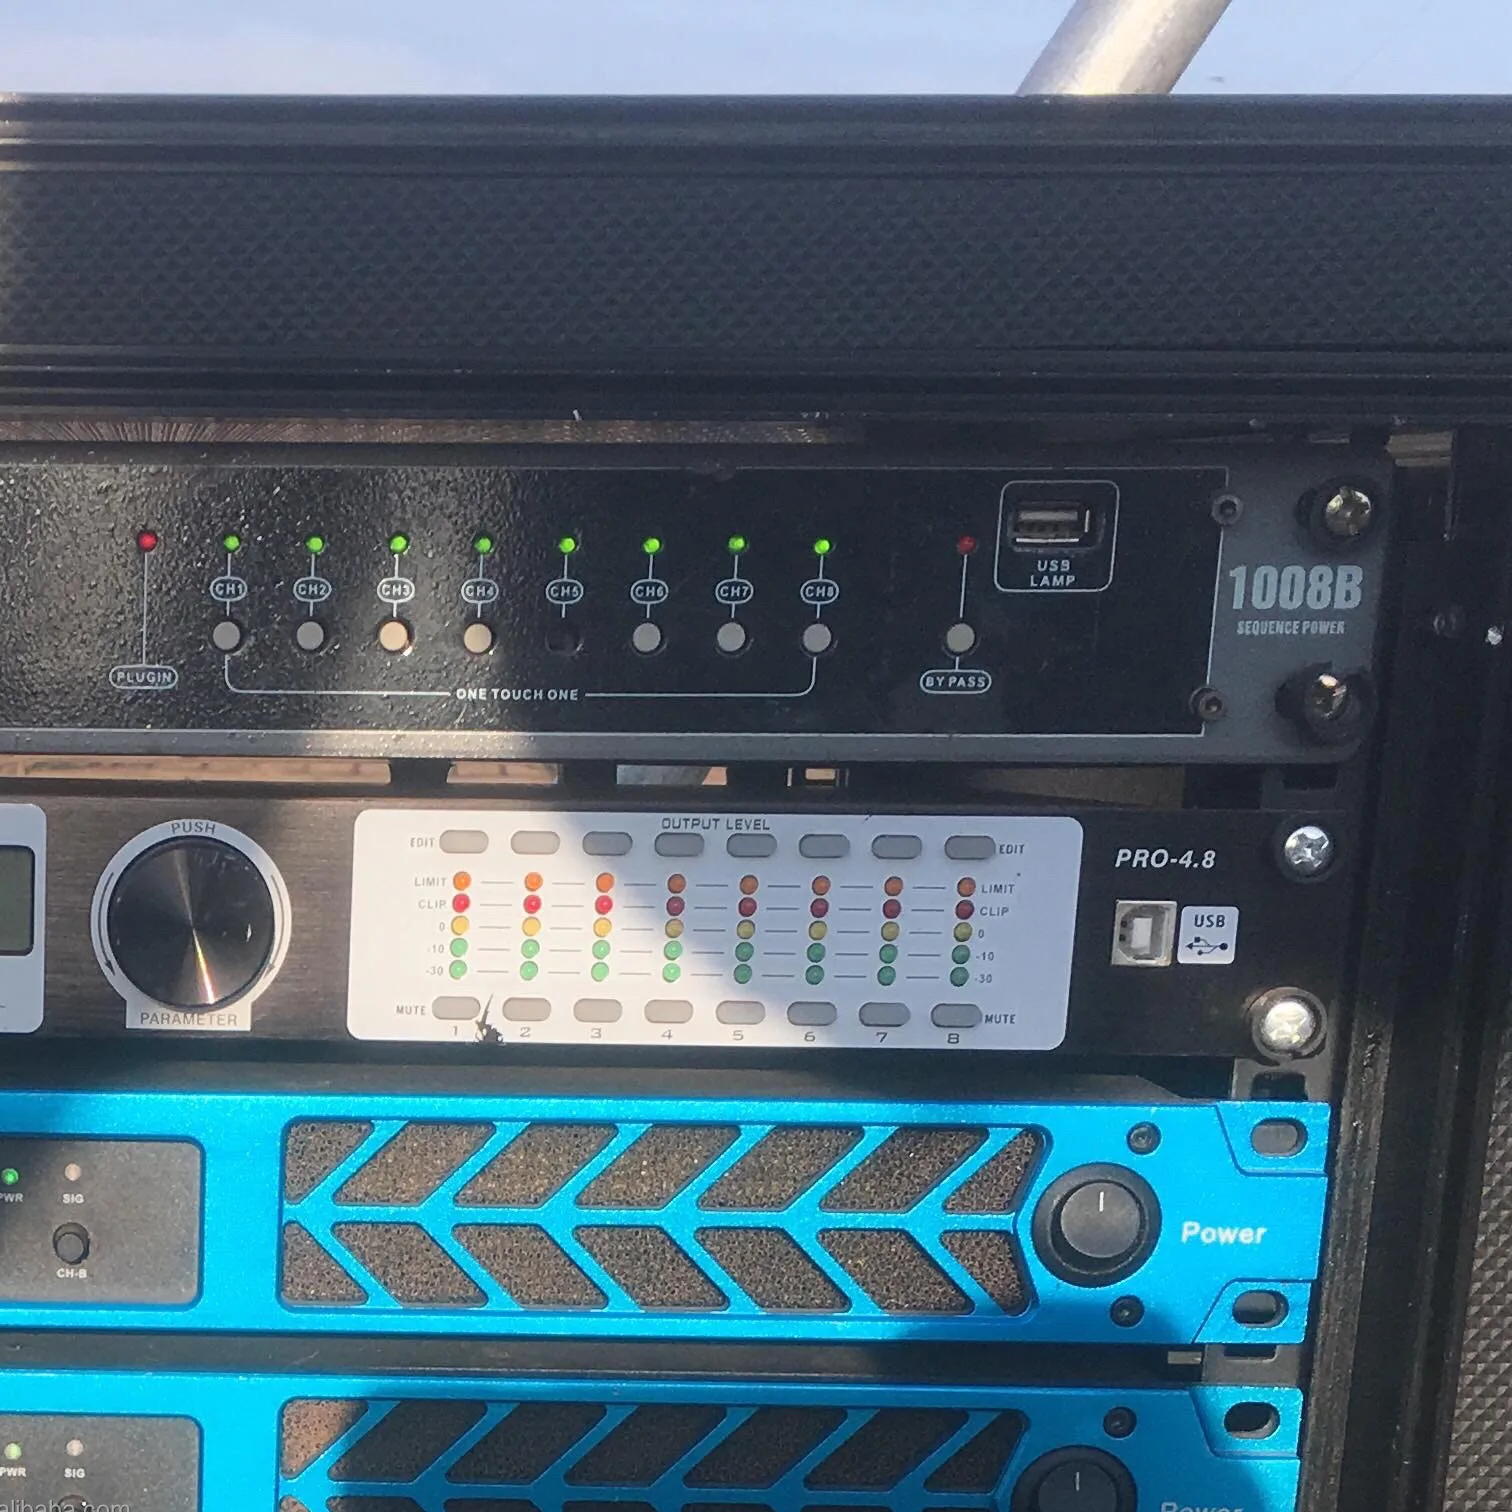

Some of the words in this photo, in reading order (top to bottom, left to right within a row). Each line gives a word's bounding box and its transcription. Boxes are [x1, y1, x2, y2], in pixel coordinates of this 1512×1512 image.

[1037, 560, 1070, 571] USB
[1030, 574, 1076, 586] LAMP
[215, 583, 243, 595] CH1
[298, 583, 327, 596] CH2
[382, 584, 411, 596] CH3
[465, 585, 494, 597] CH4
[550, 585, 579, 598] CH5
[634, 585, 664, 598] CH6
[719, 585, 749, 598] CH7
[805, 585, 835, 598] CH8
[1229, 565, 1363, 610] 1008B
[1237, 620, 1299, 635] SEQUENCE
[1302, 620, 1345, 635] POWER
[116, 671, 172, 684] PLUGIN
[925, 675, 944, 687] BY
[948, 676, 985, 688] PASS
[456, 688, 487, 700] ONE
[491, 688, 544, 700] TOUCH
[547, 689, 578, 700] ONE
[171, 822, 215, 836] PUSH
[662, 818, 720, 831] OUTPUT
[726, 818, 770, 831] LEVEL
[410, 838, 435, 848] EDIT
[999, 844, 1025, 855] EDIT
[1115, 849, 1216, 869] PRO-4.8
[414, 877, 447, 887] LIMIT
[981, 884, 1016, 894] LIMIT
[418, 900, 446, 910] CLIP
[980, 906, 1009, 917] CLIP
[1194, 914, 1225, 928] USB
[439, 922, 446, 932] 0
[978, 929, 985, 939] 0
[975, 951, 994, 961] -10
[974, 973, 993, 984] -30
[396, 1005, 426, 1016] MUTE
[140, 1013, 237, 1027] PARAMETER
[985, 1014, 1016, 1025] MUTE
[453, 1025, 459, 1036] 1
[520, 1026, 531, 1038] 2
[590, 1028, 602, 1039] 3
[661, 1028, 673, 1040] 4
[732, 1030, 744, 1041] 5
[804, 1031, 816, 1042] 6
[876, 1032, 887, 1043] 7
[947, 1033, 960, 1044] 8
[63, 1194, 84, 1204] SIG
[1181, 1221, 1267, 1245] Power
[0, 1467, 26, 1478] PWR
[64, 1468, 86, 1479] SIG
